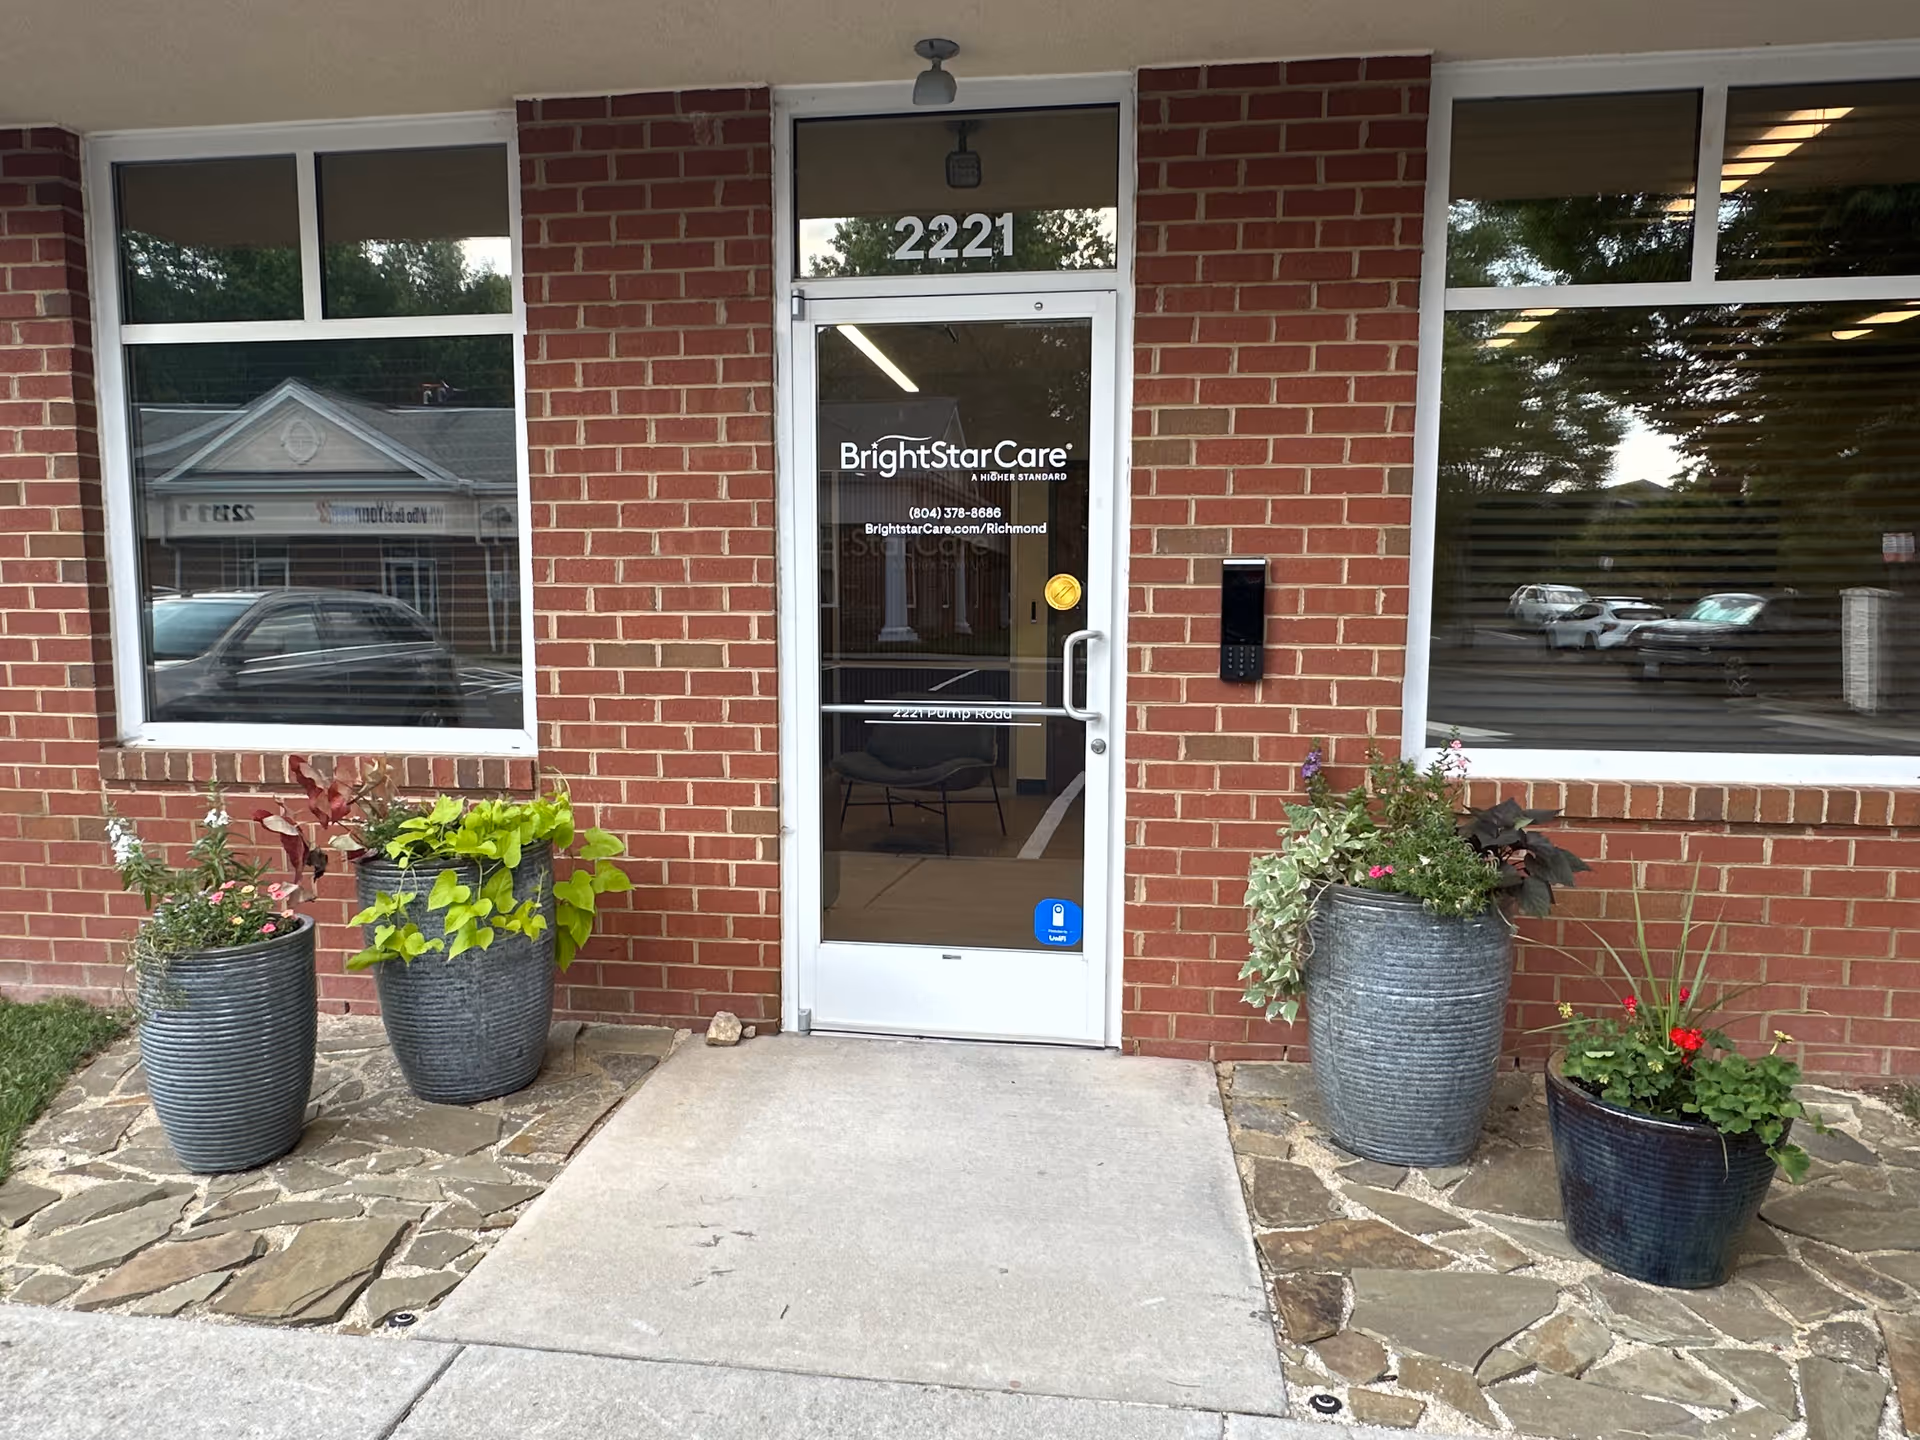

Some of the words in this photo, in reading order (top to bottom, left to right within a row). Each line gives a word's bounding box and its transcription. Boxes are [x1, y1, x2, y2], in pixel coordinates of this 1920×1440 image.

[895, 212, 1013, 260] 2221
[840, 438, 1068, 478] BrightStarCare
[971, 473, 978, 482] A
[980, 473, 1016, 482] HIGHER
[1017, 472, 1067, 482] STANDARD
[909, 507, 942, 520] (804)
[943, 507, 1002, 519] 378-8686
[865, 522, 1047, 537] BrightstarCare.com/Richmond
[892, 706, 923, 718] 2221
[927, 707, 971, 721] Pump
[975, 708, 1012, 719] Road
